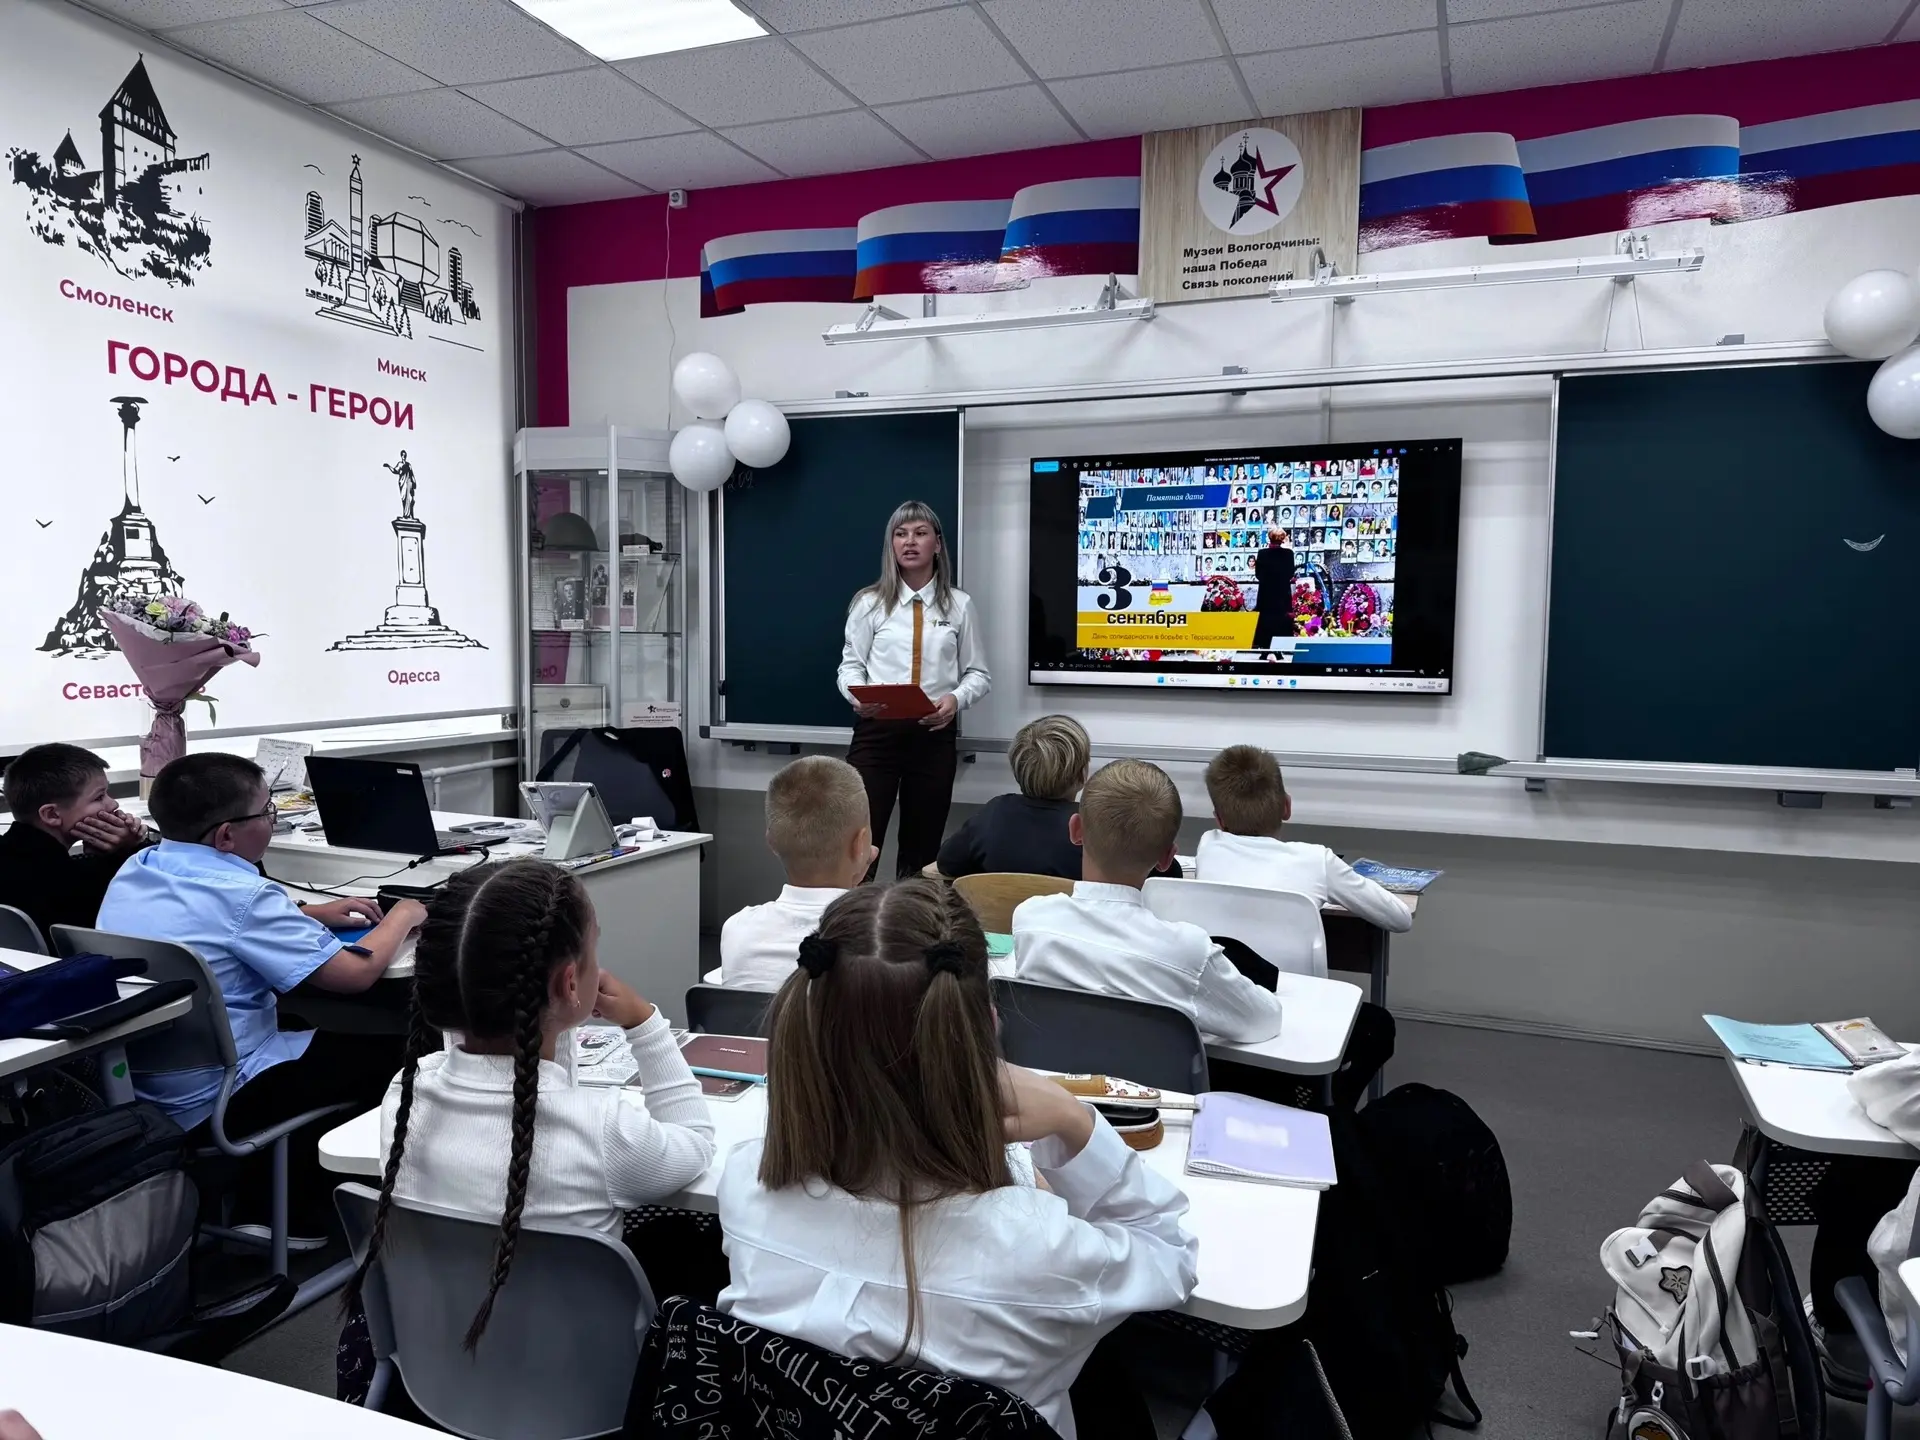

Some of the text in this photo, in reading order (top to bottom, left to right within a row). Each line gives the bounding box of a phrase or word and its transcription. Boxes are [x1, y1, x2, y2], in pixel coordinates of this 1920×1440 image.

[1184, 238, 1321, 259] Музеи Вологодчины:
[1182, 259, 1268, 274] наша Победа
[1182, 271, 1294, 290] Связь поколений
[59, 279, 174, 323] Смоленск
[376, 357, 428, 383] Минск
[107, 339, 278, 407] ГОРОДА
[309, 383, 415, 431] ГЕРОИ
[1145, 492, 1205, 503] Памятная дата
[1096, 566, 1133, 611] 3
[1106, 610, 1188, 629] сентября
[387, 669, 441, 686] Одесса
[760, 1336, 892, 1440] BULLSHIT
